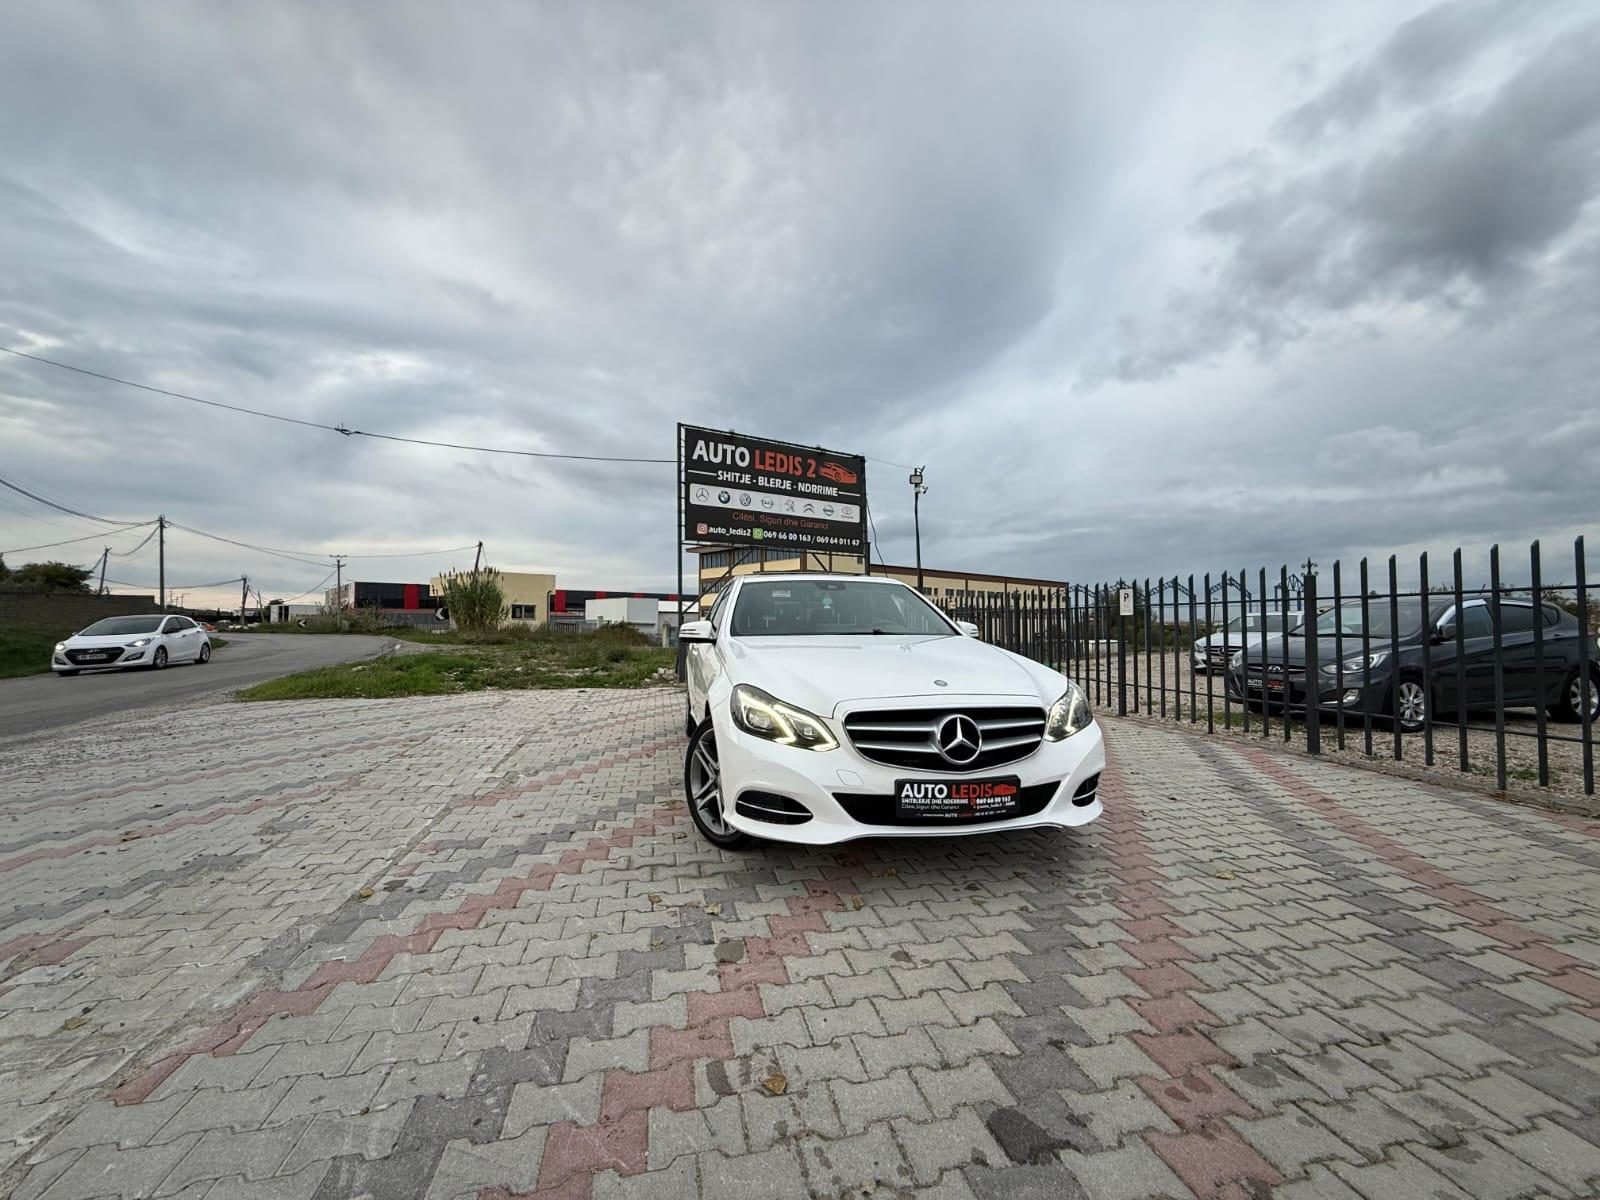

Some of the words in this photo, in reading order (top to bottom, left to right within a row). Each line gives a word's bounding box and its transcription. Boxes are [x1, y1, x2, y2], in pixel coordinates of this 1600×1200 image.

[692, 440, 750, 467] AUTO
[754, 449, 803, 476] LEDIS
[806, 458, 816, 479] 2
[717, 470, 752, 484] SHITJE
[758, 477, 792, 490] BLERJE
[798, 482, 839, 497] NDRRIME
[763, 531, 777, 539] 069
[778, 532, 787, 540] 66
[788, 533, 798, 541] 00
[799, 534, 811, 542] 163
[816, 535, 829, 544] 069
[829, 537, 838, 545] 64
[901, 784, 947, 798] AUTO
[951, 784, 992, 798] LEDIS
